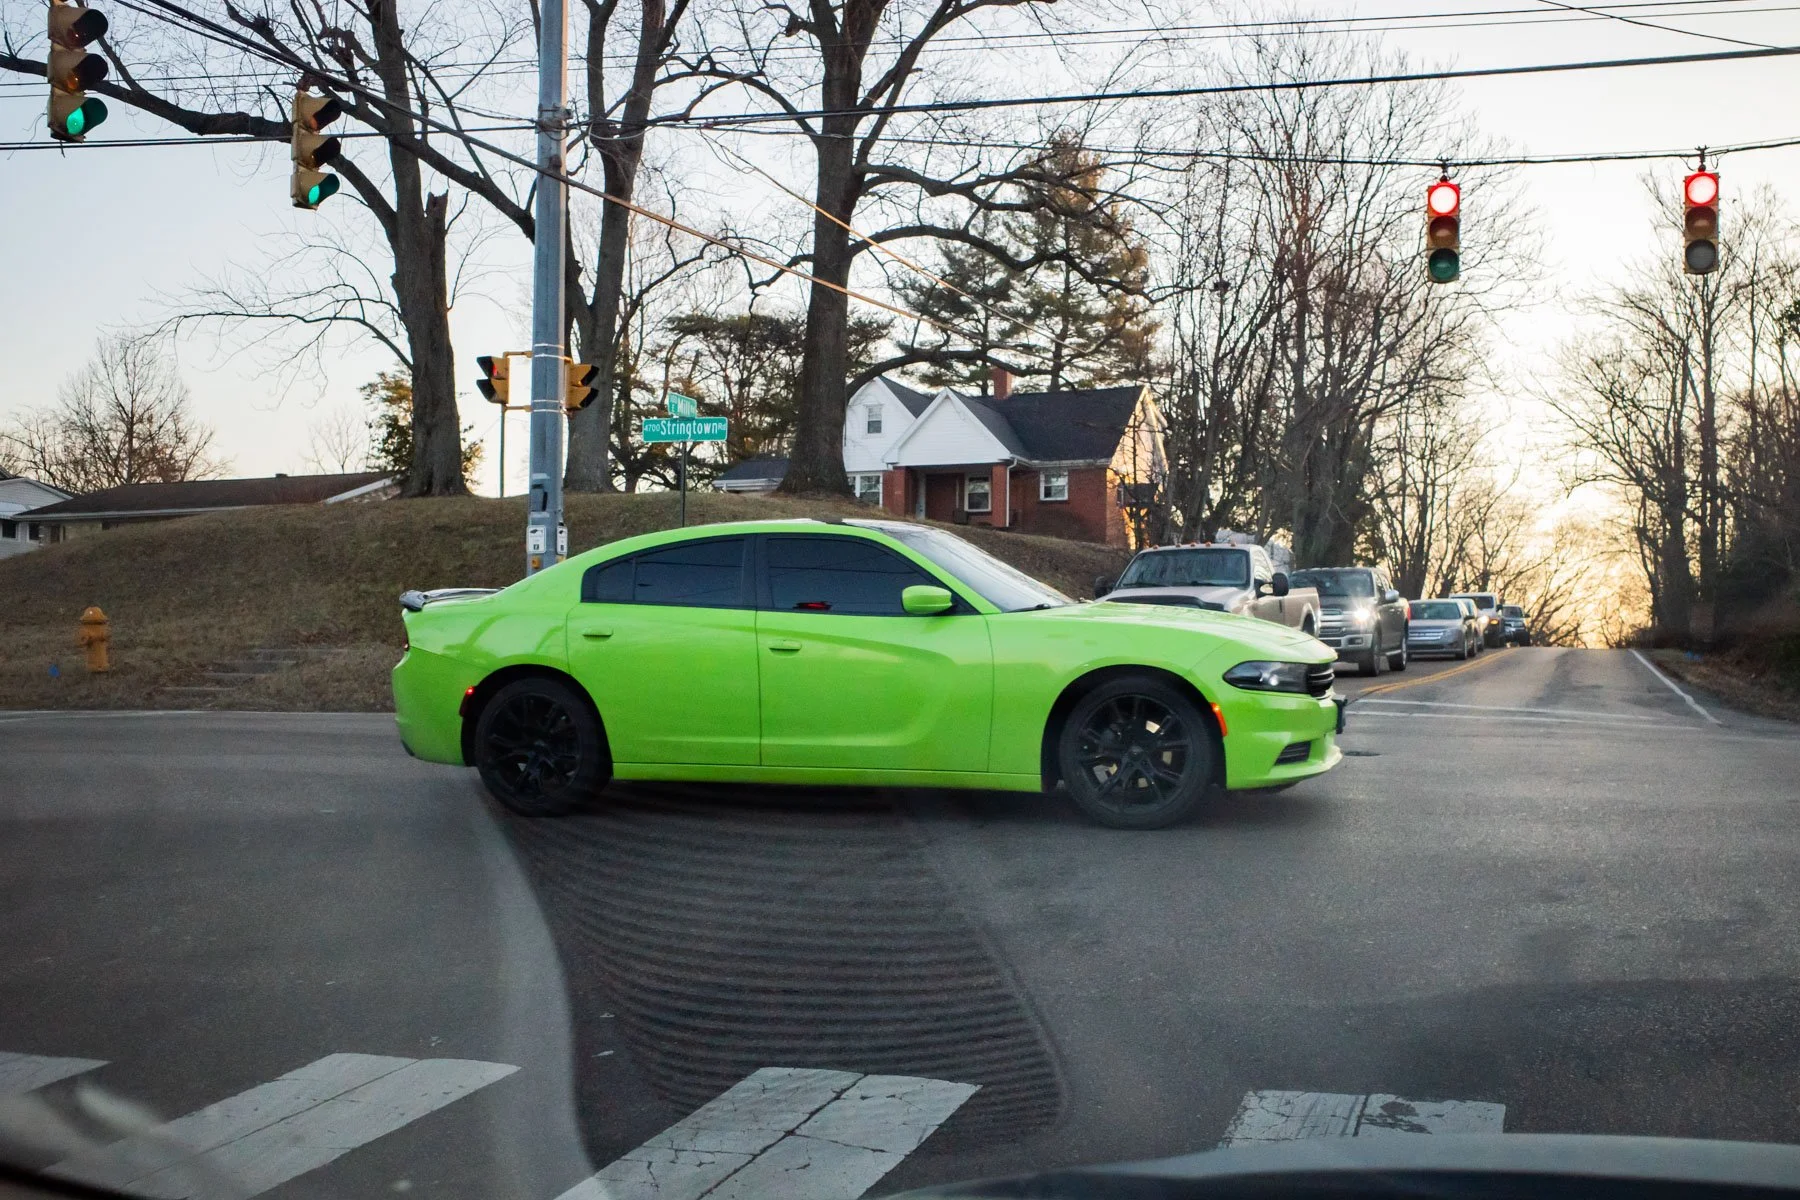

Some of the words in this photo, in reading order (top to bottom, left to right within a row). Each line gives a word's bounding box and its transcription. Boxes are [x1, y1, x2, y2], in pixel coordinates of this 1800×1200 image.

[677, 397, 691, 415] Mill
[644, 423, 660, 432] 4700
[660, 420, 718, 439] Stringtown
[718, 422, 727, 431] Rd
